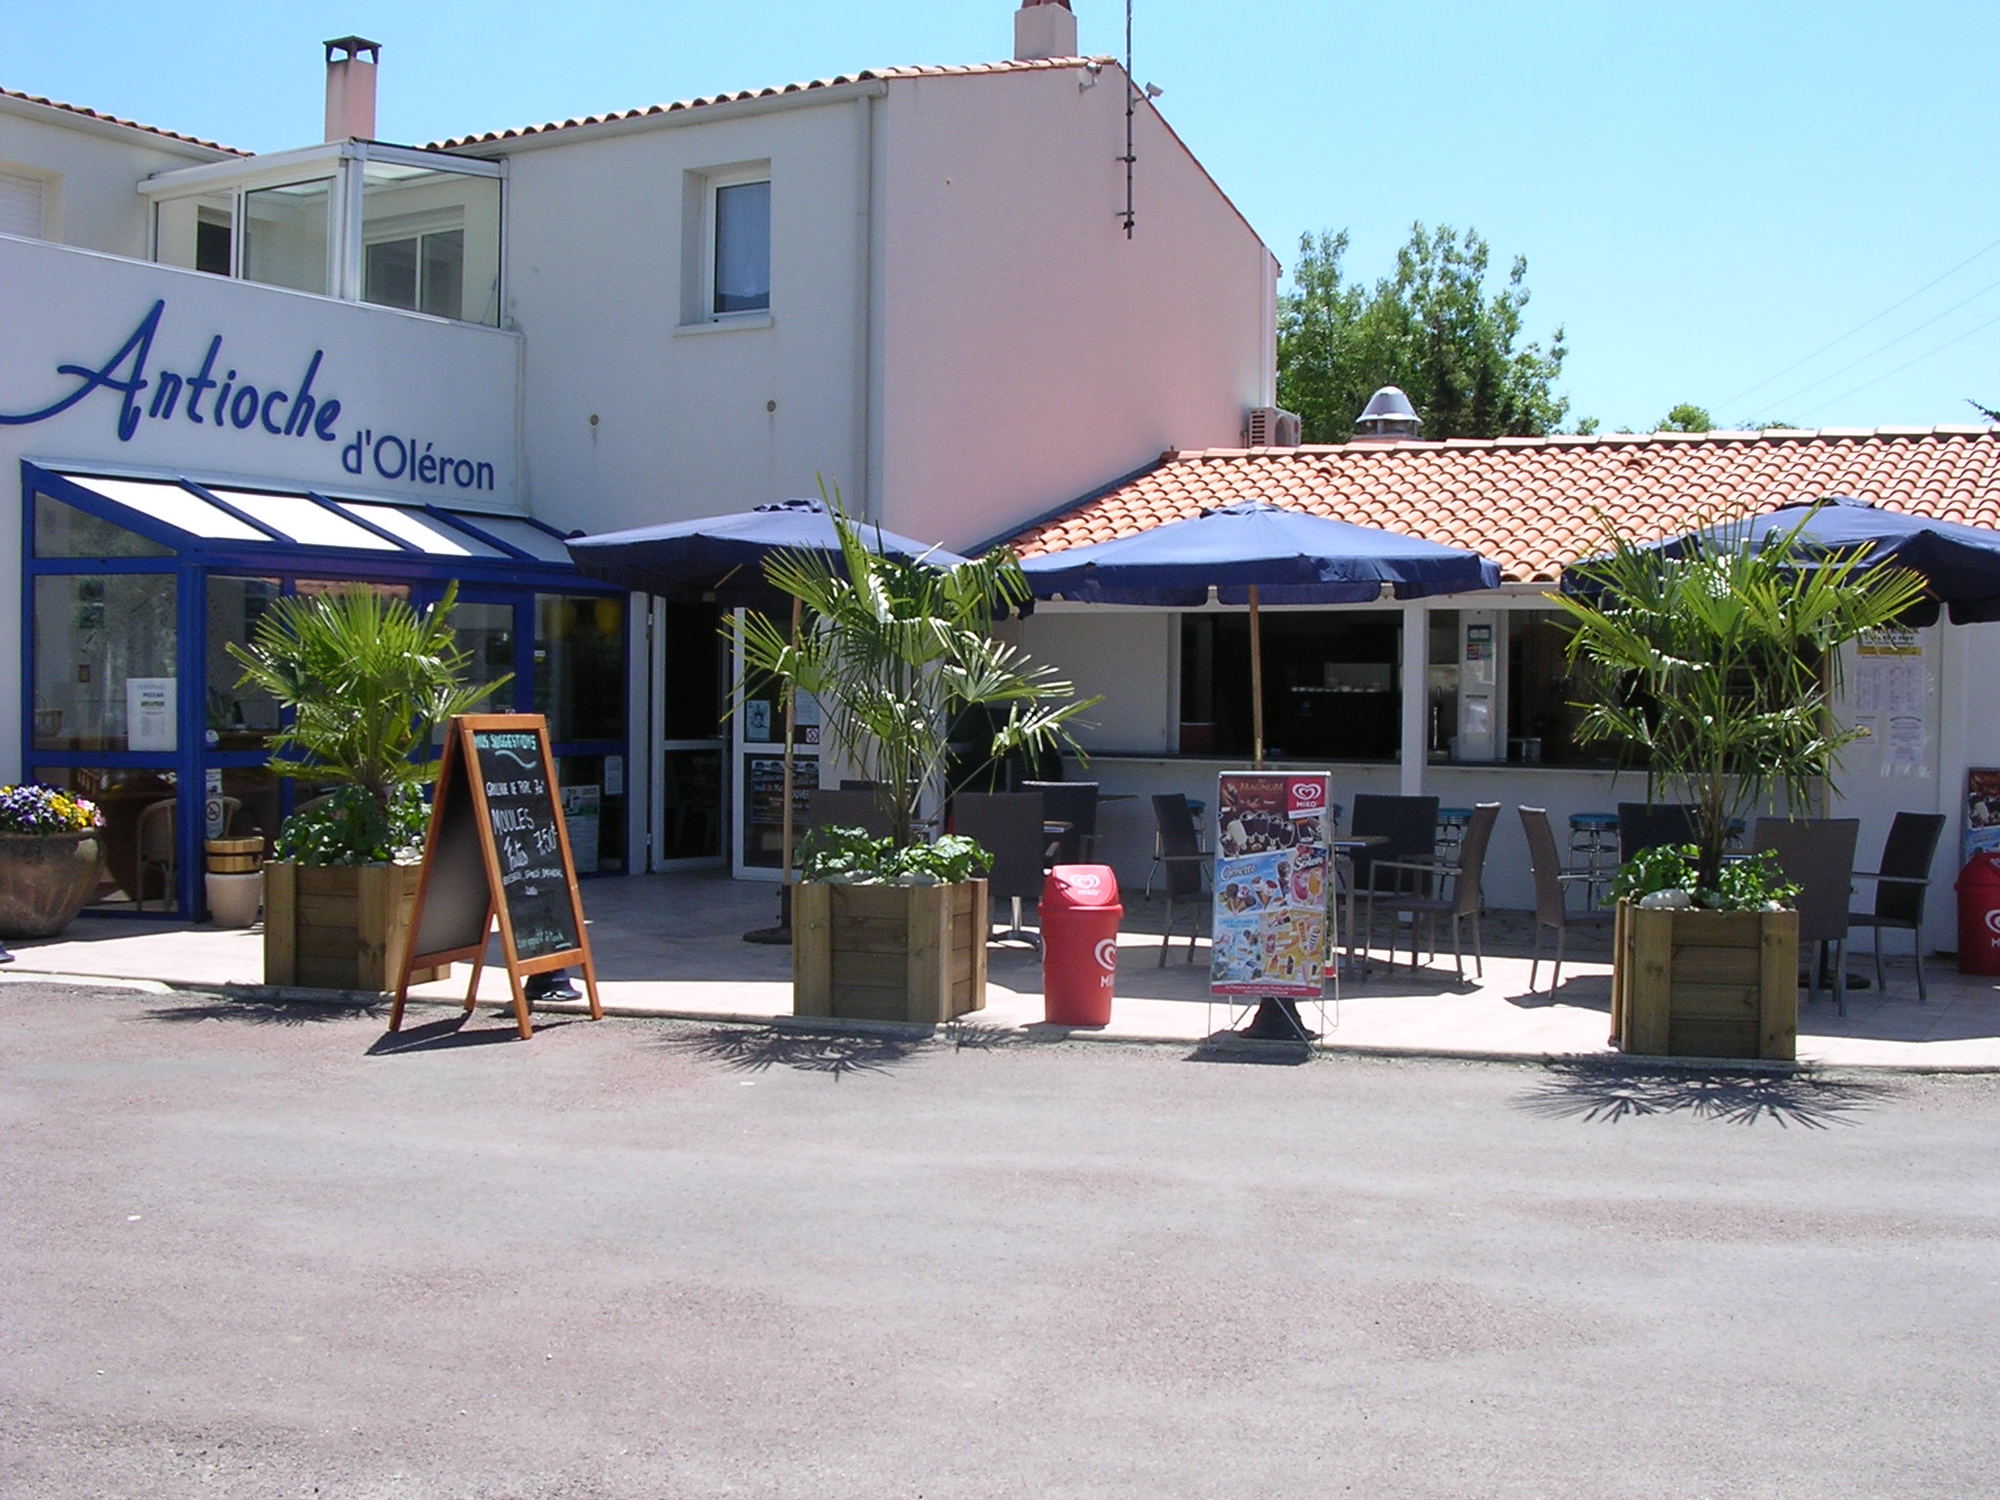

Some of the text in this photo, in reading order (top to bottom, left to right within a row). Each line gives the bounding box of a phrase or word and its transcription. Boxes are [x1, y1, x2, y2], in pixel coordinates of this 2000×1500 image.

[0, 299, 495, 491] Antioche d'Oléron
[490, 734, 537, 751] SUGGESTIONS
[491, 807, 535, 836] MOULES
